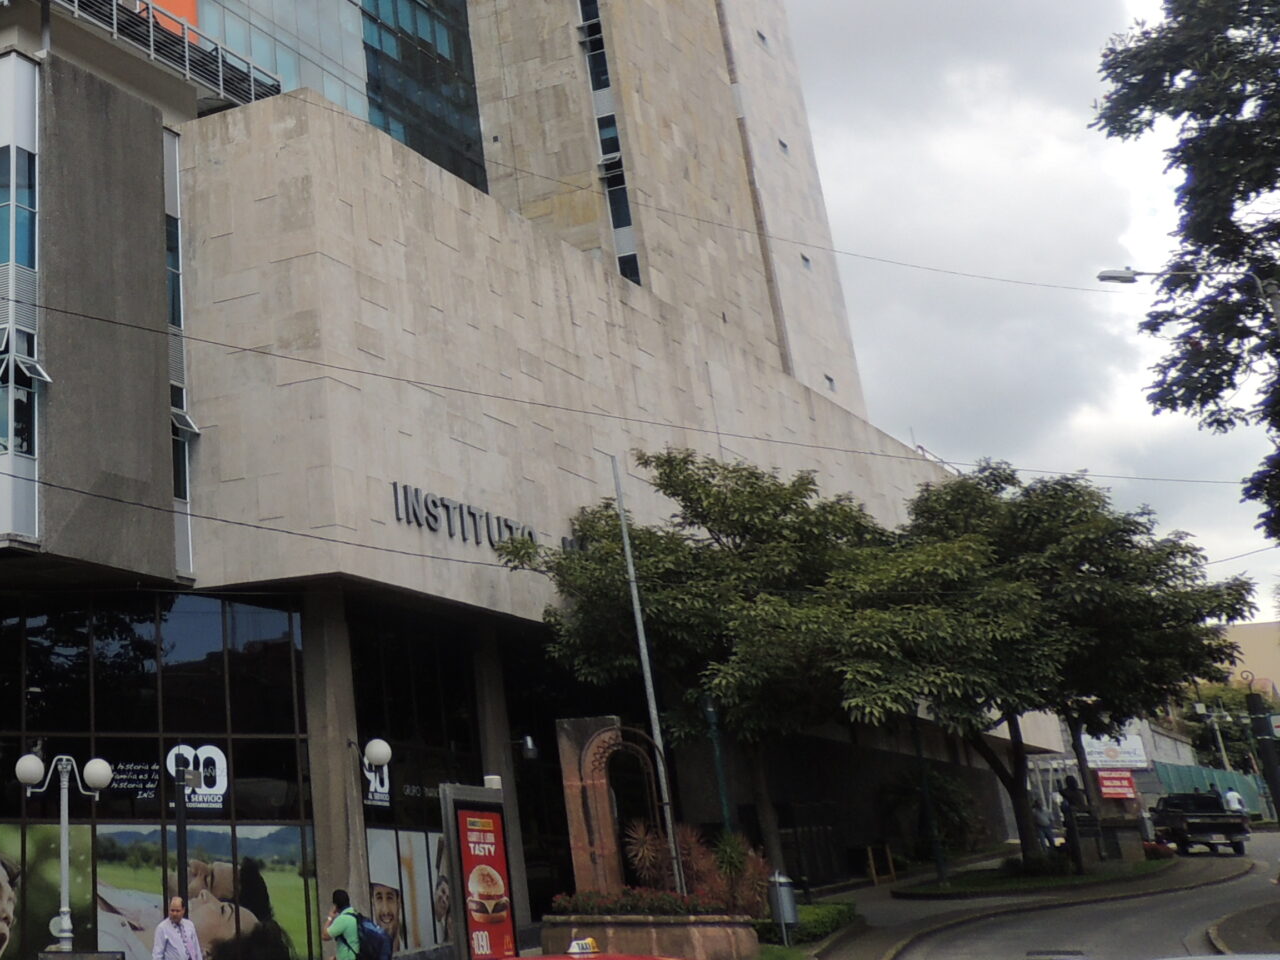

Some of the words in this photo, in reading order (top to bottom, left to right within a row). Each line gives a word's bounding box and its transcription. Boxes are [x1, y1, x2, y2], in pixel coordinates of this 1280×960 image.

[116, 762, 149, 770] historia
[150, 761, 160, 770] de
[151, 771, 159, 780] la
[111, 780, 143, 788] historia
[145, 780, 158, 788] del
[136, 790, 155, 799] INS
[468, 843, 496, 857] TASTY
